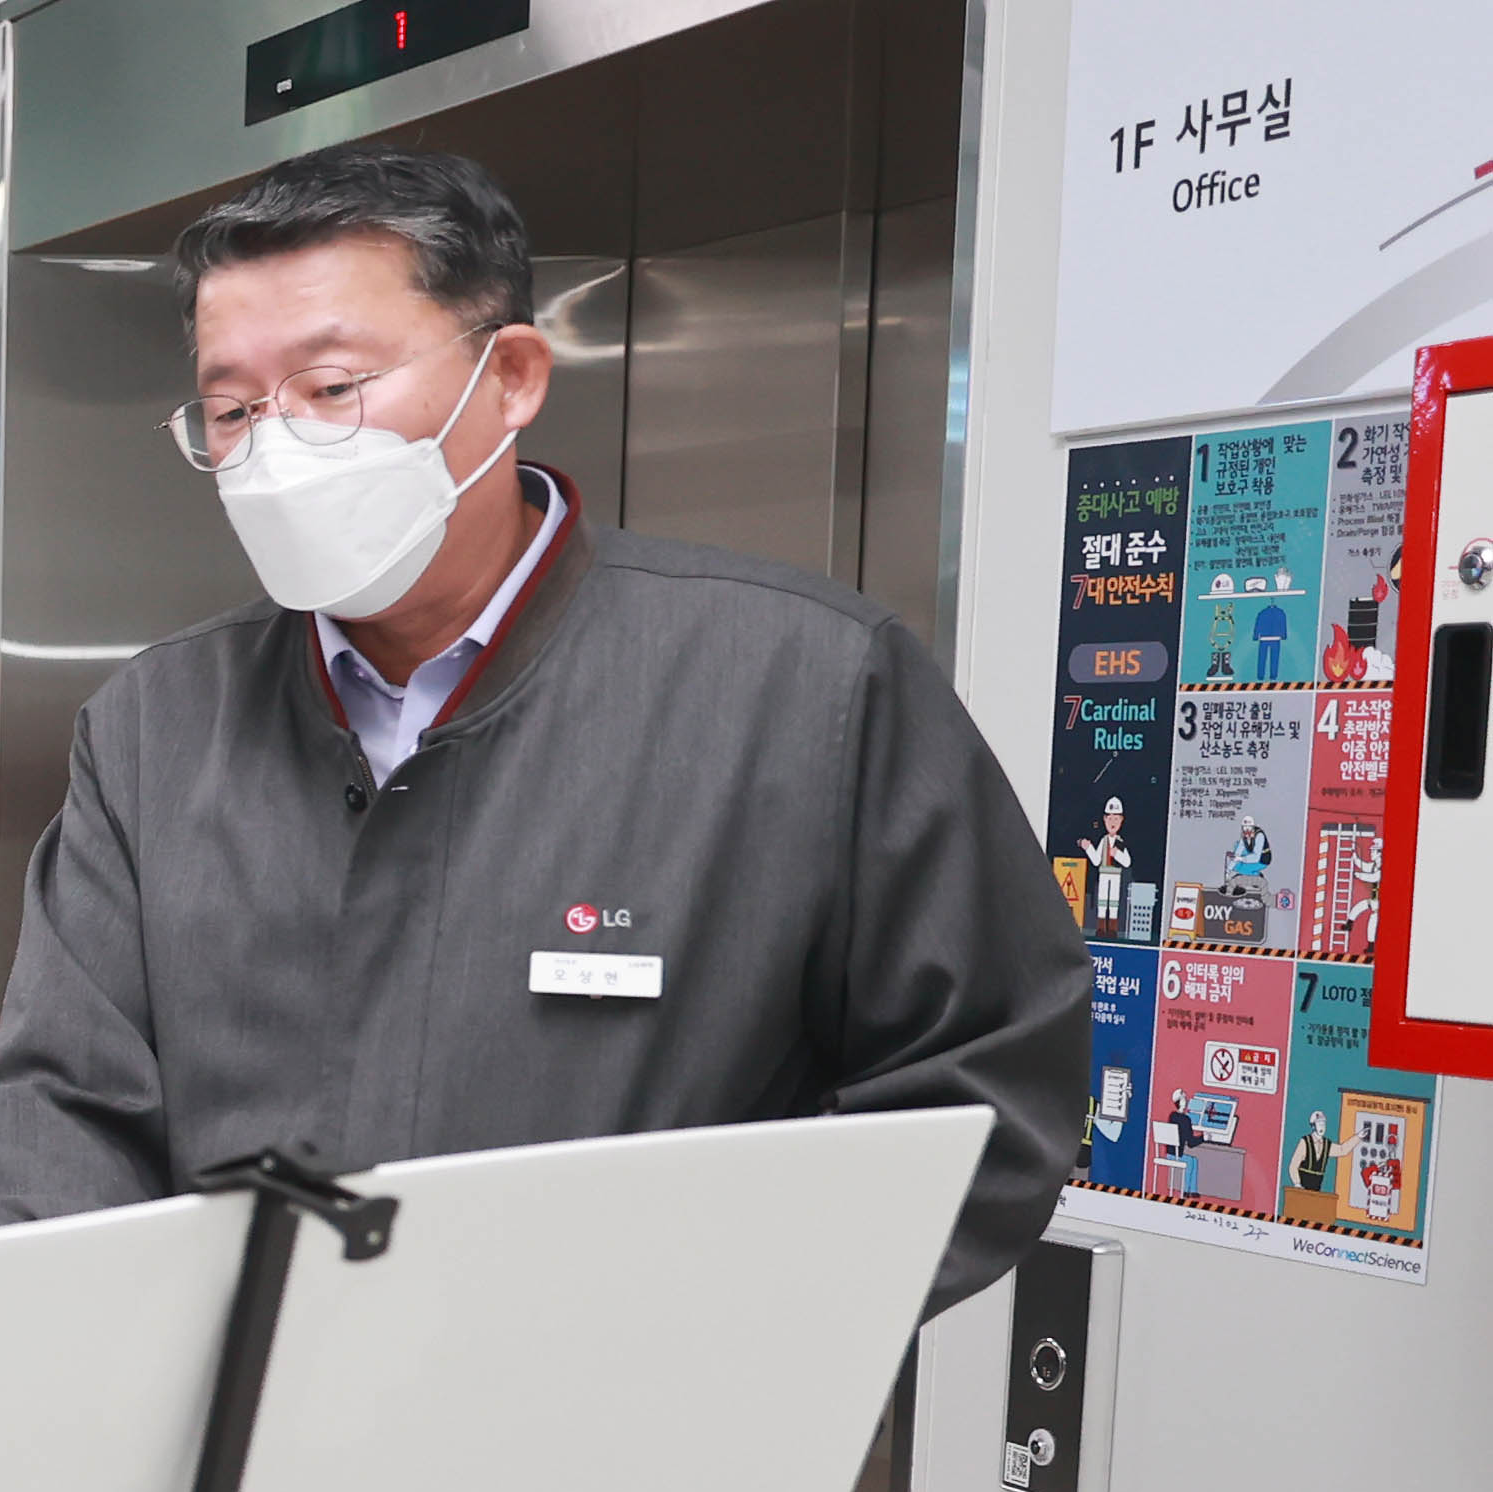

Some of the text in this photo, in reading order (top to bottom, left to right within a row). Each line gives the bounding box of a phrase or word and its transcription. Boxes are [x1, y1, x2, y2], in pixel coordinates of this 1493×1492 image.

[395, 11, 407, 49] 1
[1109, 78, 1292, 173] 1F 사무실
[1172, 170, 1260, 213] Office
[1283, 434, 1308, 455] 맞는
[1363, 424, 1389, 444] 화기
[1336, 426, 1359, 470] 2
[1362, 444, 1401, 465] 가연성
[1196, 443, 1211, 483] 1
[1361, 463, 1402, 486] 측정 및
[1215, 477, 1275, 496] 보호구 착용
[1077, 490, 1141, 522] 중대사고
[1145, 486, 1180, 515] 예방
[1082, 533, 1121, 569] 절대
[1125, 530, 1167, 566] 준수
[1094, 649, 1141, 676] EHS
[1177, 701, 1198, 741] 3
[1202, 702, 1273, 720] 밀폐공간 출입
[1317, 699, 1339, 741] 4
[1094, 726, 1144, 752] Rules
[1201, 721, 1301, 741] 작업 시 유해가스 및
[1199, 740, 1270, 759] 산소농도 측정
[1203, 904, 1234, 920] OXY
[1224, 920, 1254, 936] GAS
[1095, 974, 1141, 996] 작업 실시
[1162, 959, 1182, 1000] 6
[1185, 962, 1245, 985] 인터록 임의
[1184, 982, 1232, 1003] 해제 금지
[1298, 972, 1318, 1013] 7
[1322, 985, 1357, 1003] LOTO
[1292, 1237, 1422, 1274] WeConnectScience
